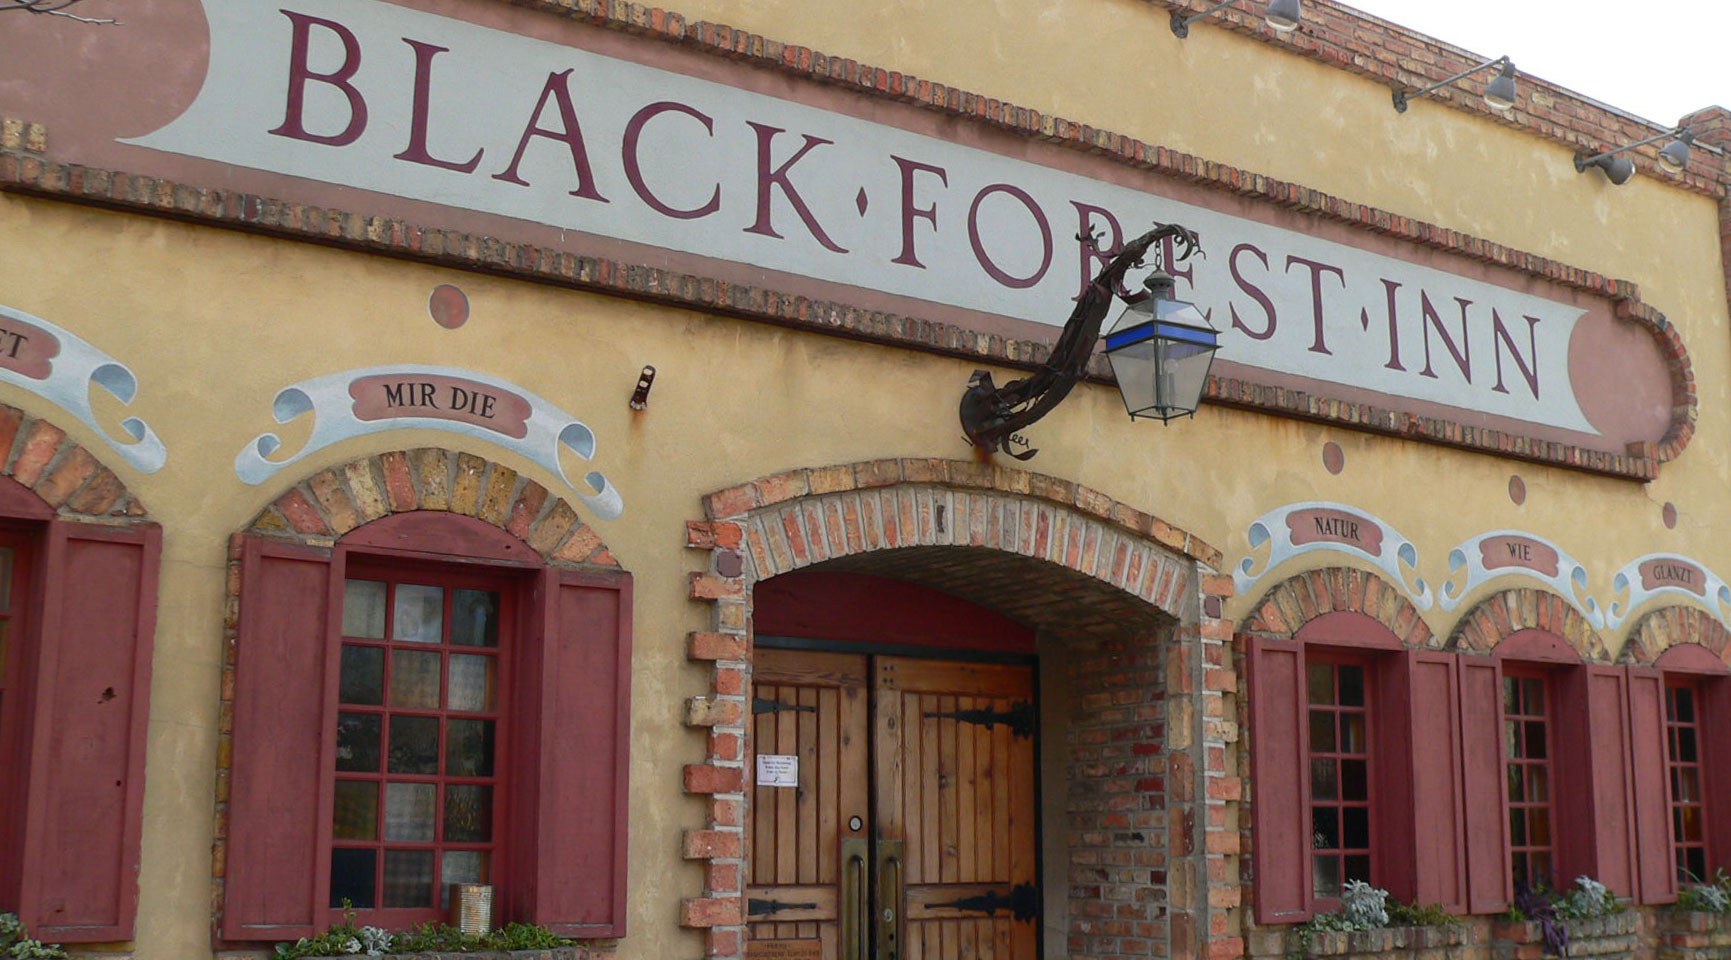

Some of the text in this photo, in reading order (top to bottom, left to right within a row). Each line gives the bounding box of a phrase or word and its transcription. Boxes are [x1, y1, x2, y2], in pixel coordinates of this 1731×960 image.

[268, 8, 1541, 401] BLACK FOREST INN
[383, 382, 497, 419] MIR DIE
[1313, 516, 1361, 541] NATUR
[1506, 542, 1533, 561] WIE
